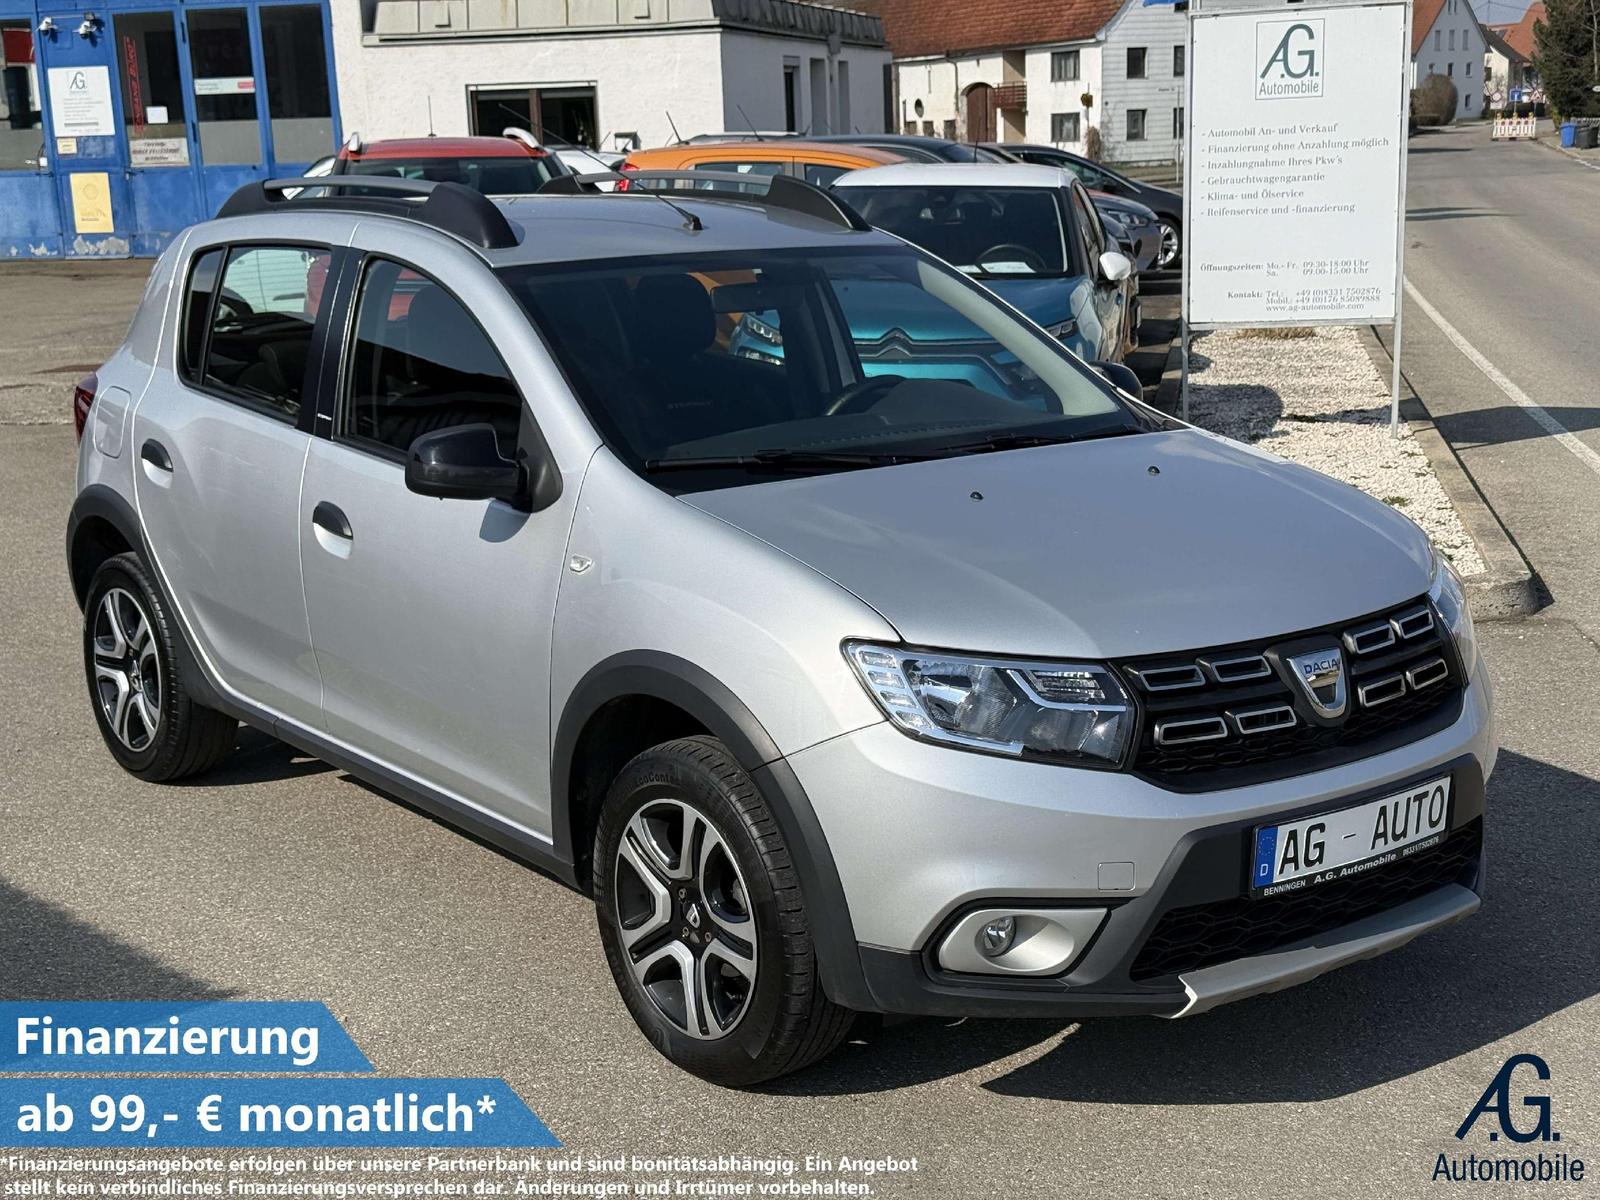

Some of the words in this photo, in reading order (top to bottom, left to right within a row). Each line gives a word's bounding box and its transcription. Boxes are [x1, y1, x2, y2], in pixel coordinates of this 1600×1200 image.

[1259, 80, 1319, 96] Automobile
[1207, 127, 1256, 138] Automobil
[1258, 127, 1276, 136] An-
[1278, 126, 1296, 135] und
[1299, 123, 1338, 134] Verkauf
[1207, 142, 1270, 154] Finanzierung
[1272, 142, 1295, 151] ohne
[1298, 140, 1349, 150] Anzahlung
[1352, 137, 1389, 148] möglich
[1207, 159, 1286, 170] Inzahlungnahme
[1288, 157, 1313, 166] Ihres
[1207, 172, 1325, 186] Gebrauchtwagengarantie
[1207, 192, 1238, 201] Klima-
[1241, 190, 1259, 199] und
[1261, 188, 1304, 199] Ölservice
[1207, 206, 1269, 217] Reifenservice
[1271, 205, 1289, 215] und
[1200, 262, 1264, 272] Öffnungszeiten:
[1354, 259, 1369, 267] Uhr
[1227, 290, 1263, 299] Kontakt:
[1266, 303, 1364, 312] www.ag-automobile.com
[1304, 659, 1339, 674] DACIA
[1260, 863, 1268, 877] D
[1278, 822, 1326, 876] AG
[1370, 785, 1445, 850] AUTO
[1264, 880, 1306, 896] BENNINGEN
[1313, 873, 1337, 885] A.G.
[1340, 853, 1396, 876] Automobile
